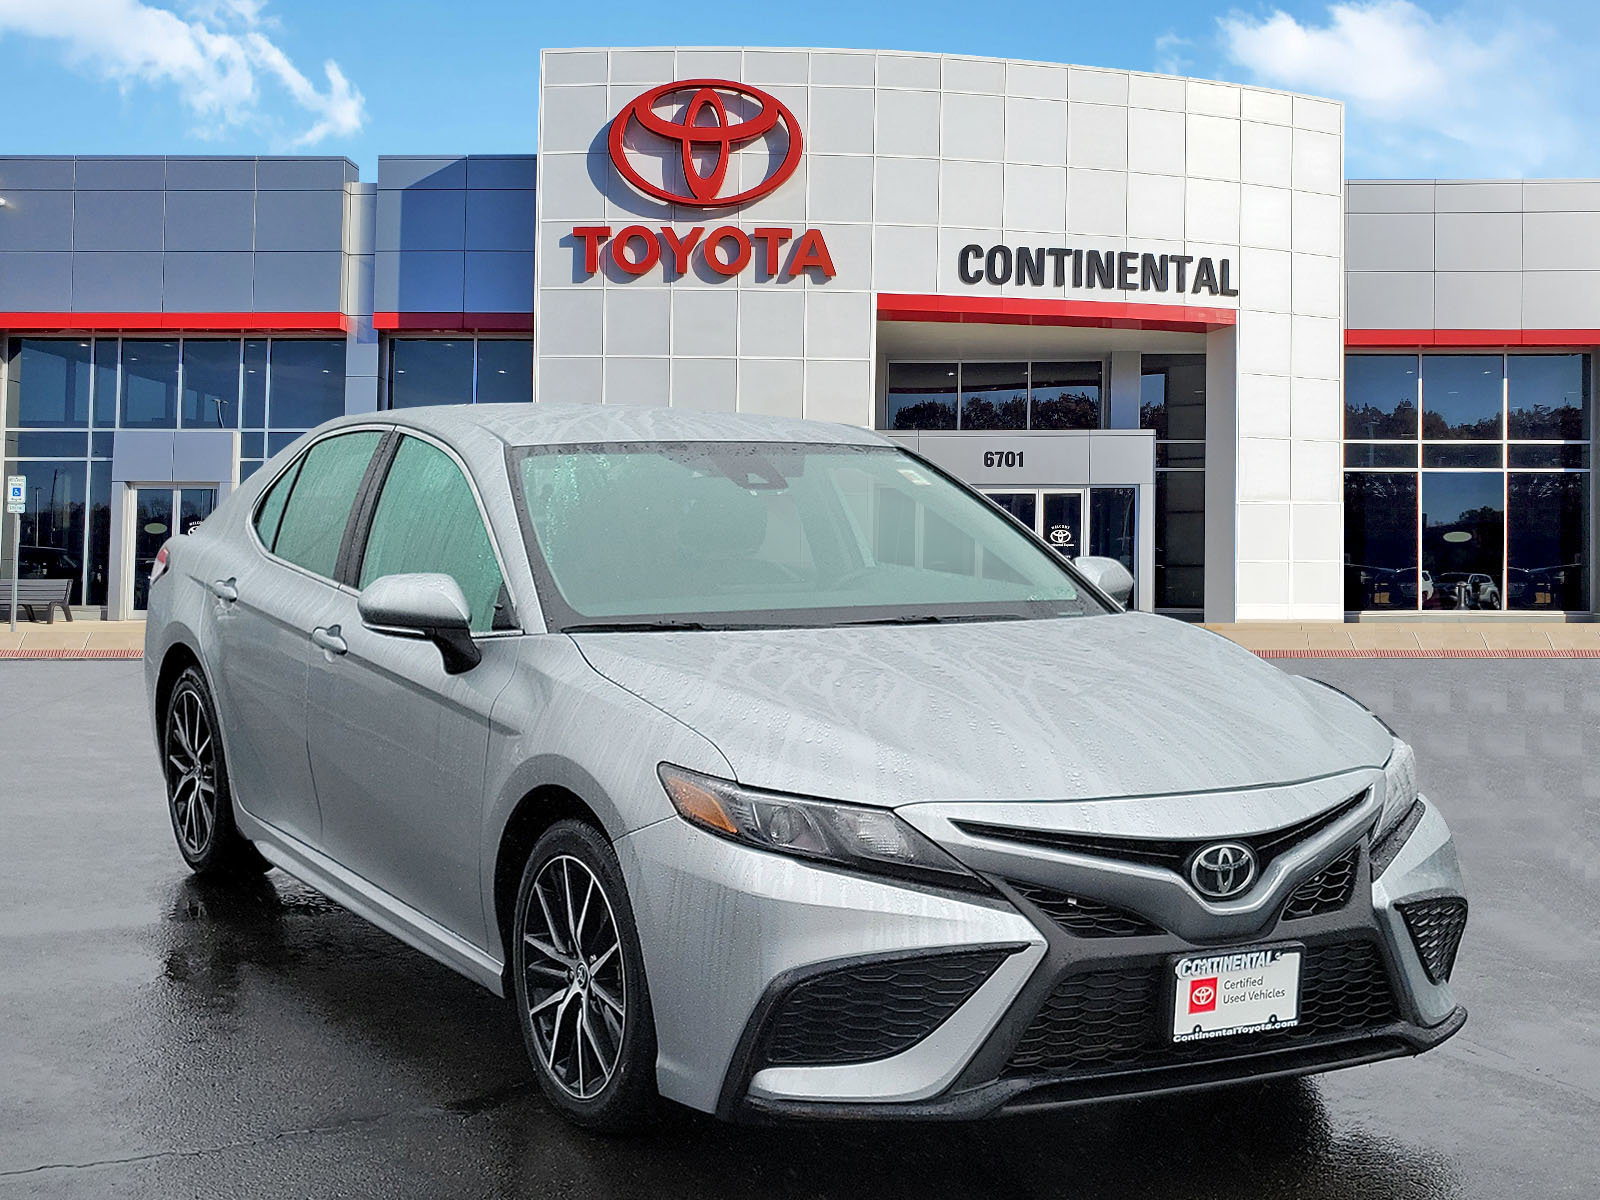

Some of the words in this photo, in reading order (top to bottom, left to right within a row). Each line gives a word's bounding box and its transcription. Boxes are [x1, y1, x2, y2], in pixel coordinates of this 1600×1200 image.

[572, 225, 837, 276] TOYOTA
[959, 244, 1239, 297] CONTINENTAL
[983, 451, 1024, 468] 6701
[1176, 951, 1273, 978] CONTINENTAL
[1223, 976, 1264, 990] Certified
[1223, 993, 1246, 1004] Used
[1248, 988, 1286, 1001] Vehicles
